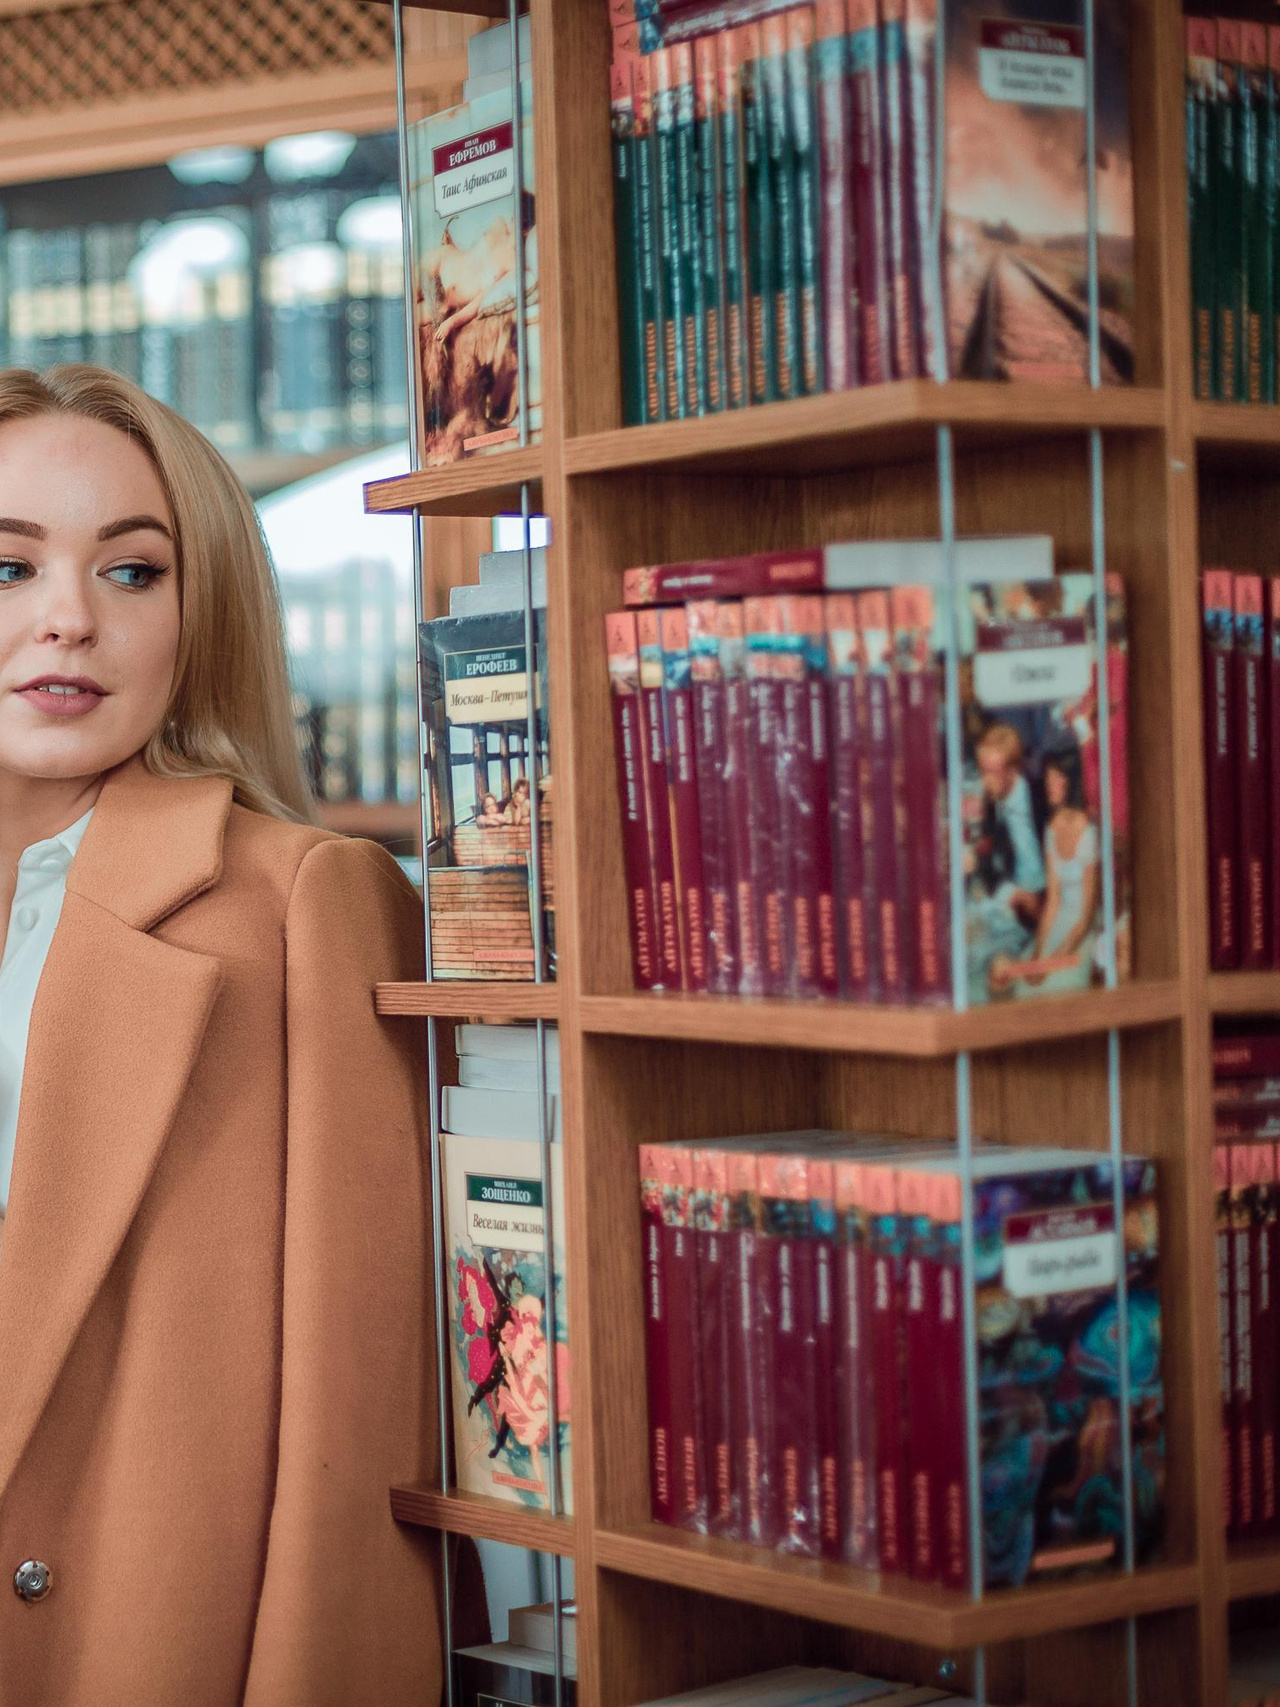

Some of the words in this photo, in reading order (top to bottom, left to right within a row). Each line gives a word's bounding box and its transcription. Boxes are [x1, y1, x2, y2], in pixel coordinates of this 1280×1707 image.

[449, 139, 497, 167] ЕФРЕМОВ
[441, 183, 461, 199] Таис
[462, 166, 508, 194] Афинская
[466, 659, 517, 676] ЕРОФЕЕВ
[635, 888, 651, 977] АЙТМАТОВ
[481, 1186, 531, 1203] ЗОЩЕНКО
[472, 1213, 508, 1231] Веселая
[511, 1221, 544, 1235] жизнь
